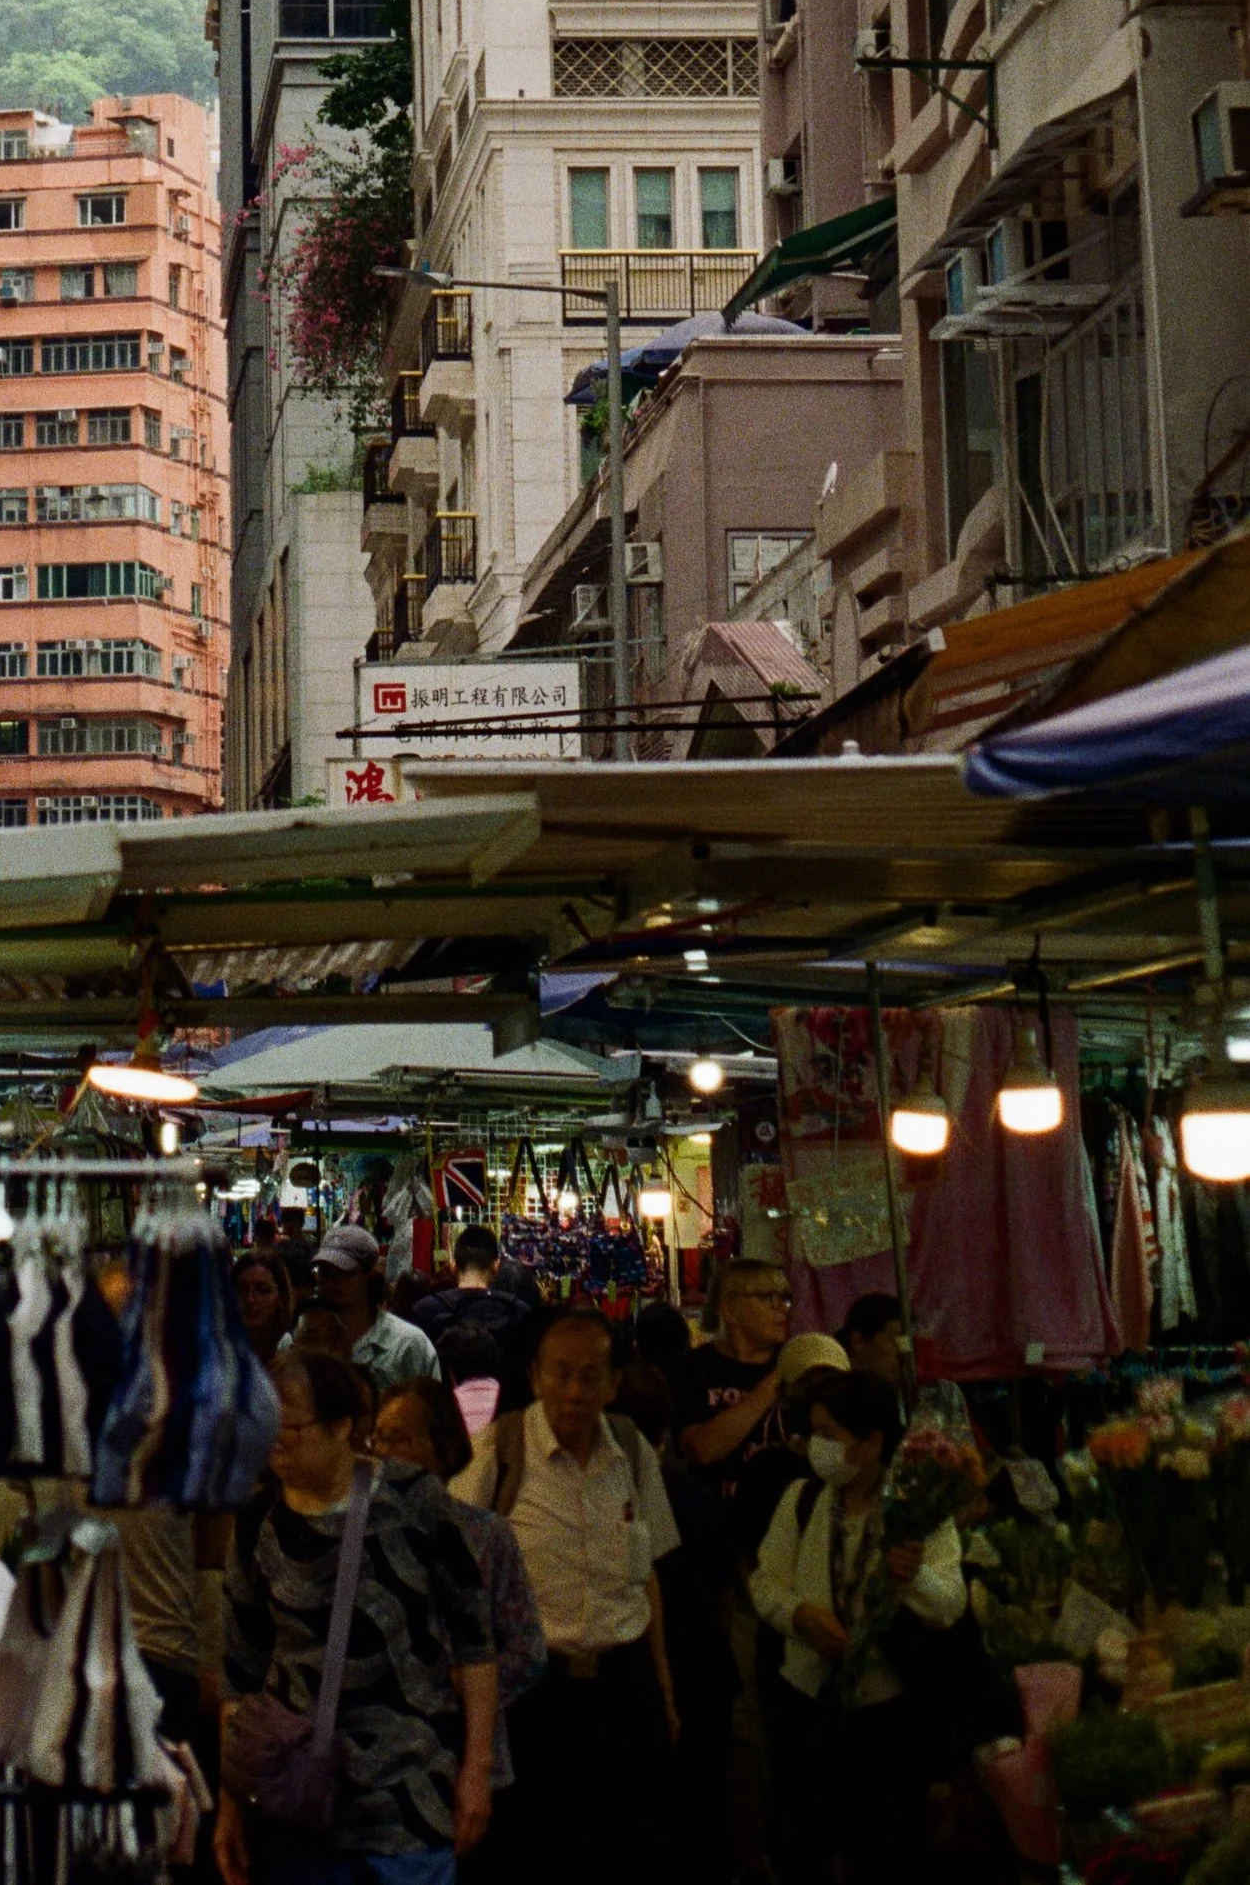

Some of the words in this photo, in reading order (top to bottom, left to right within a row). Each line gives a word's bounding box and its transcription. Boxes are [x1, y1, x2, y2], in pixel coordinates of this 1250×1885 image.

[410, 685, 567, 709] 振明工程有限公司
